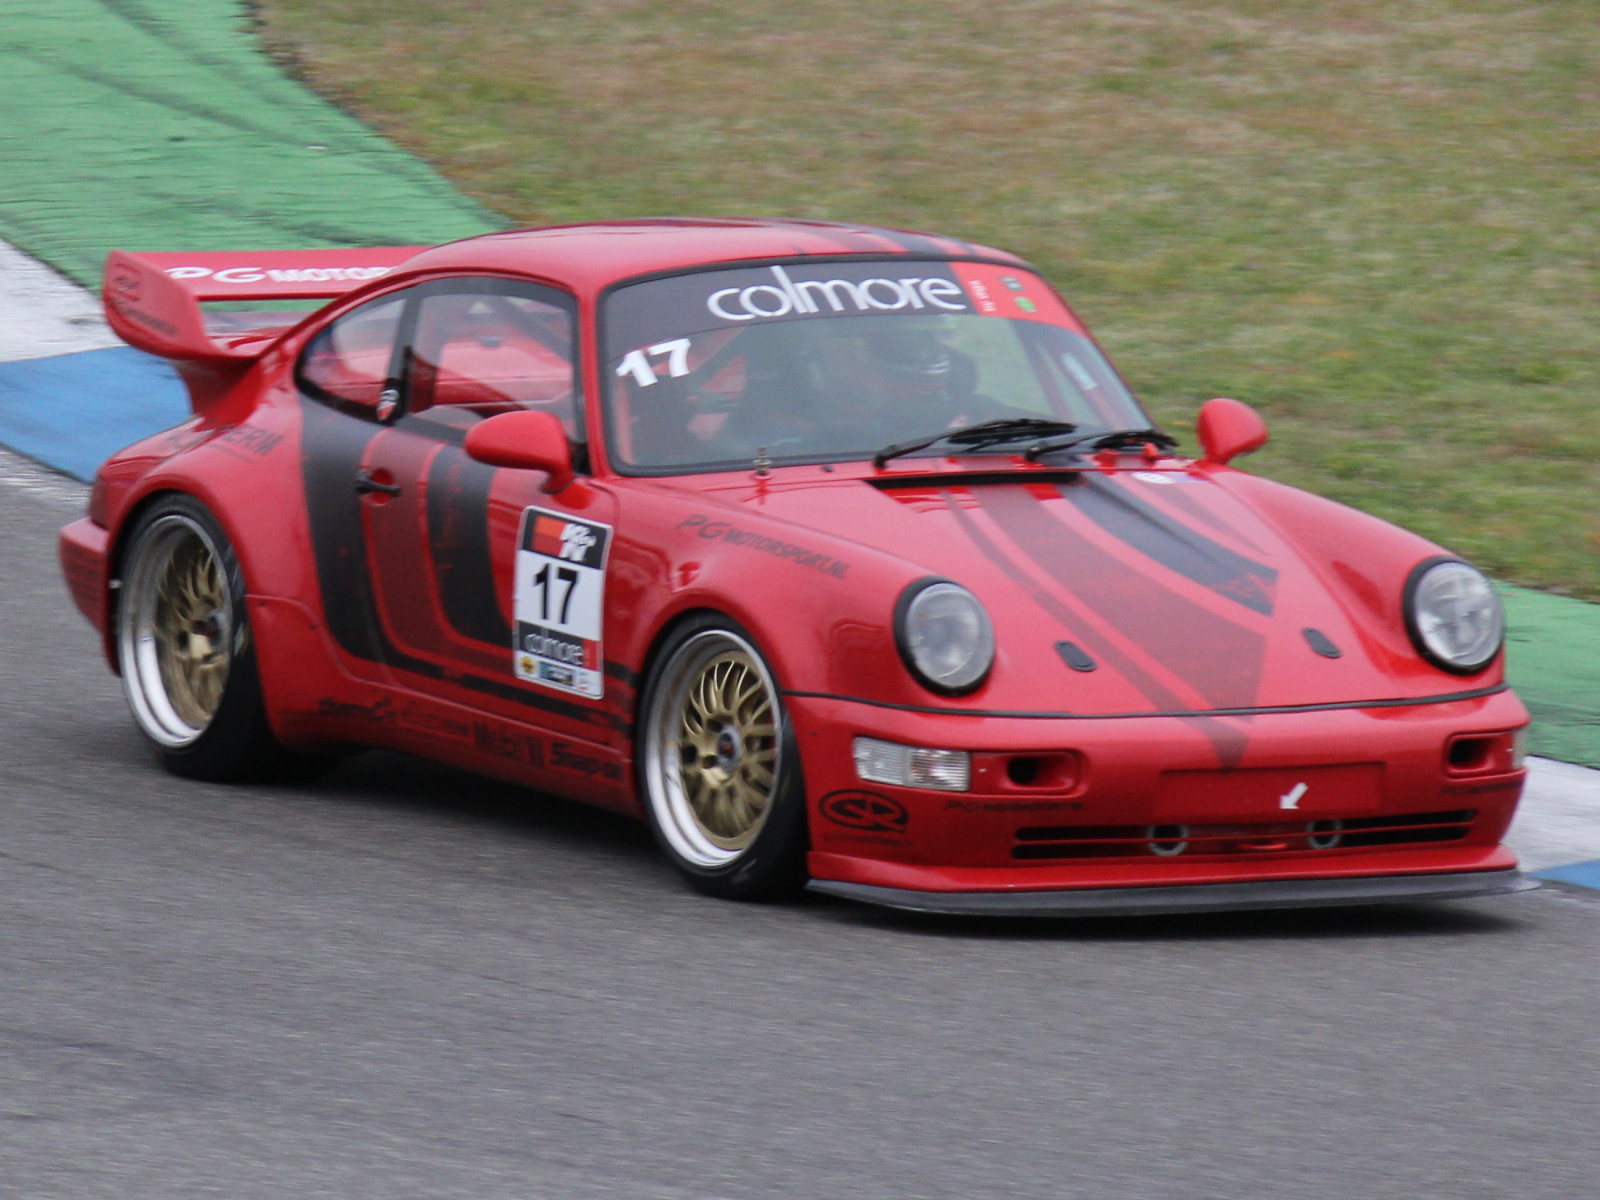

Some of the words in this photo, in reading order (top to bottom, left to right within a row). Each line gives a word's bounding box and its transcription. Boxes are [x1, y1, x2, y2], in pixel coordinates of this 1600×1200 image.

[706, 264, 967, 321] colmore
[615, 337, 692, 388] 17
[533, 562, 580, 624] 17
